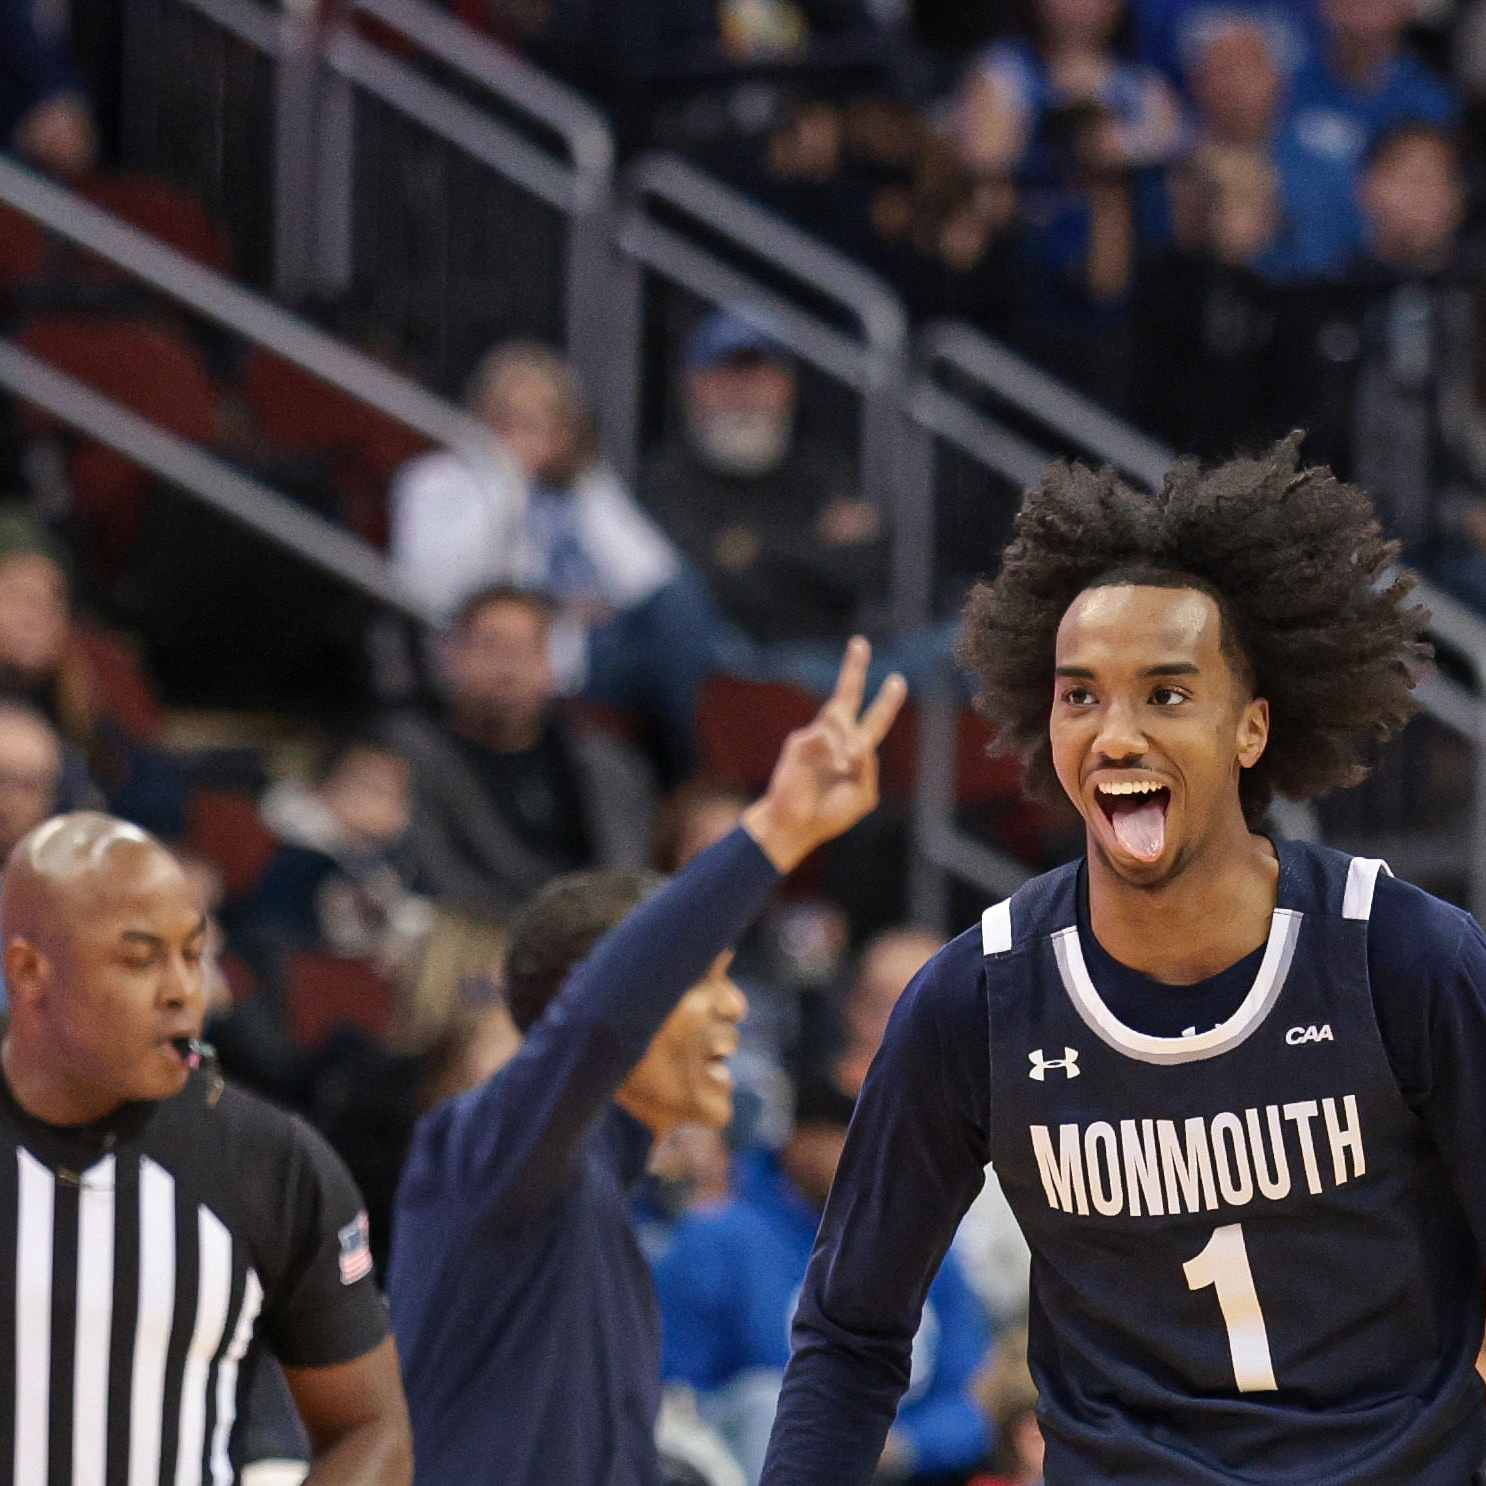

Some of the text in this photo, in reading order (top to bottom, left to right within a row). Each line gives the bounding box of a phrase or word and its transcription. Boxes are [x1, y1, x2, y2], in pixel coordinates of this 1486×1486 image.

[1285, 1024, 1334, 1045] CAA
[1029, 1094, 1366, 1217] MONMOUTH
[1182, 1222, 1279, 1393] 1
